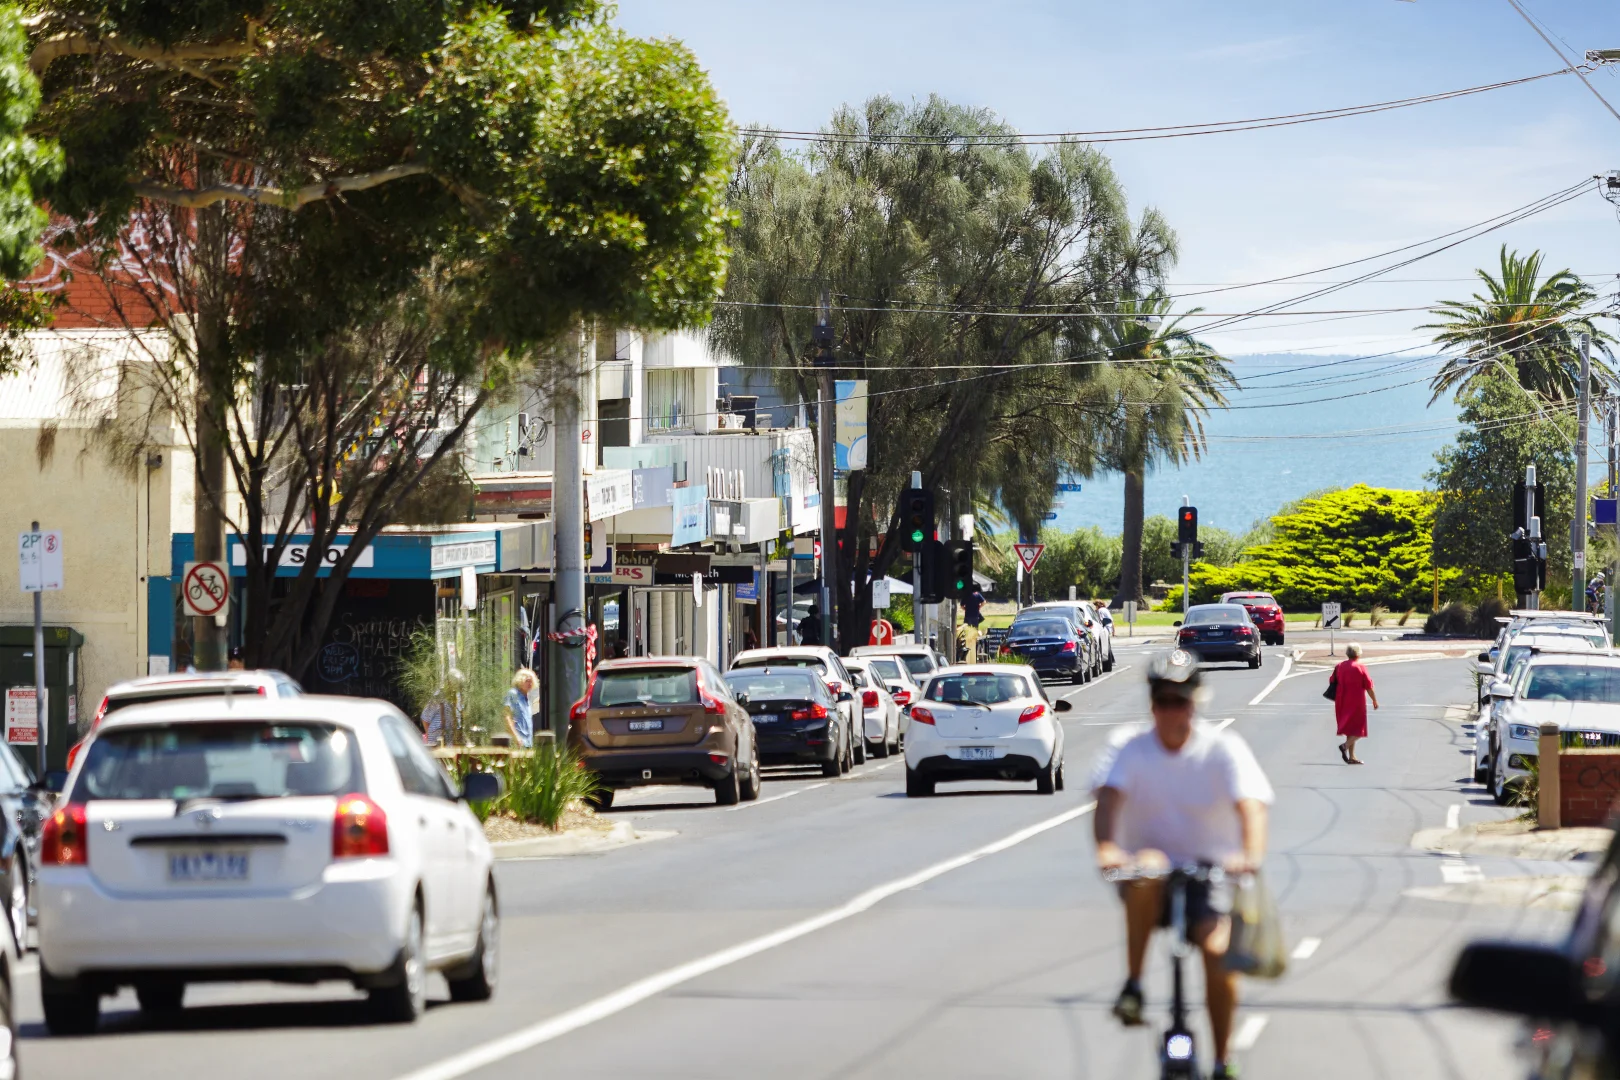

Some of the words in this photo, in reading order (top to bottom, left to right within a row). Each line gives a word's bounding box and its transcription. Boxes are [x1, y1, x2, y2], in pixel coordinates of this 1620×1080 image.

[22, 534, 38, 548] 2P
[290, 548, 348, 564] SO
[616, 567, 644, 579] ERS
[362, 637, 411, 657] HAPP
